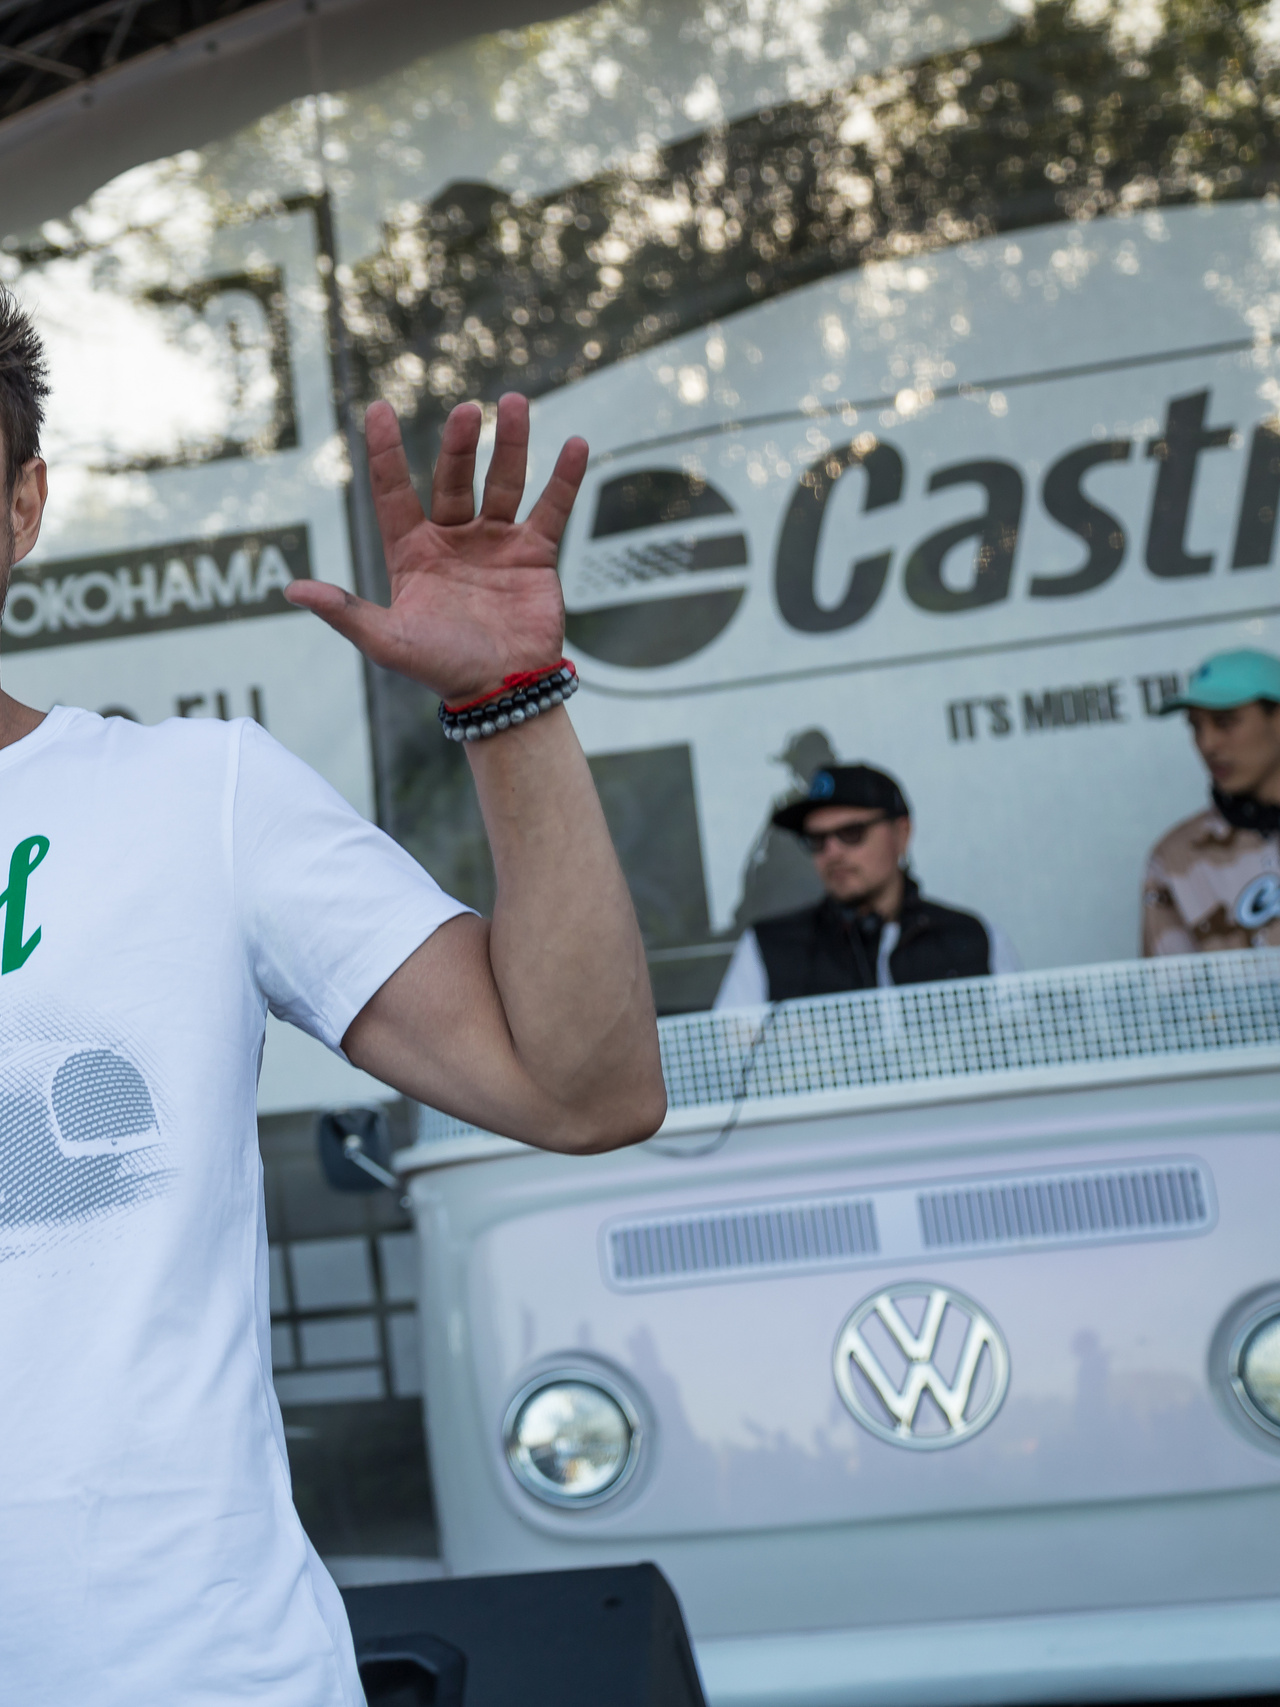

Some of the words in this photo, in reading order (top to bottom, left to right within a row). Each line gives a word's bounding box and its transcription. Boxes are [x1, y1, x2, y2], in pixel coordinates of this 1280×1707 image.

[3, 543, 295, 638] OKOHAMA
[945, 693, 1011, 741] IT'S
[1021, 680, 1124, 733] MORE
